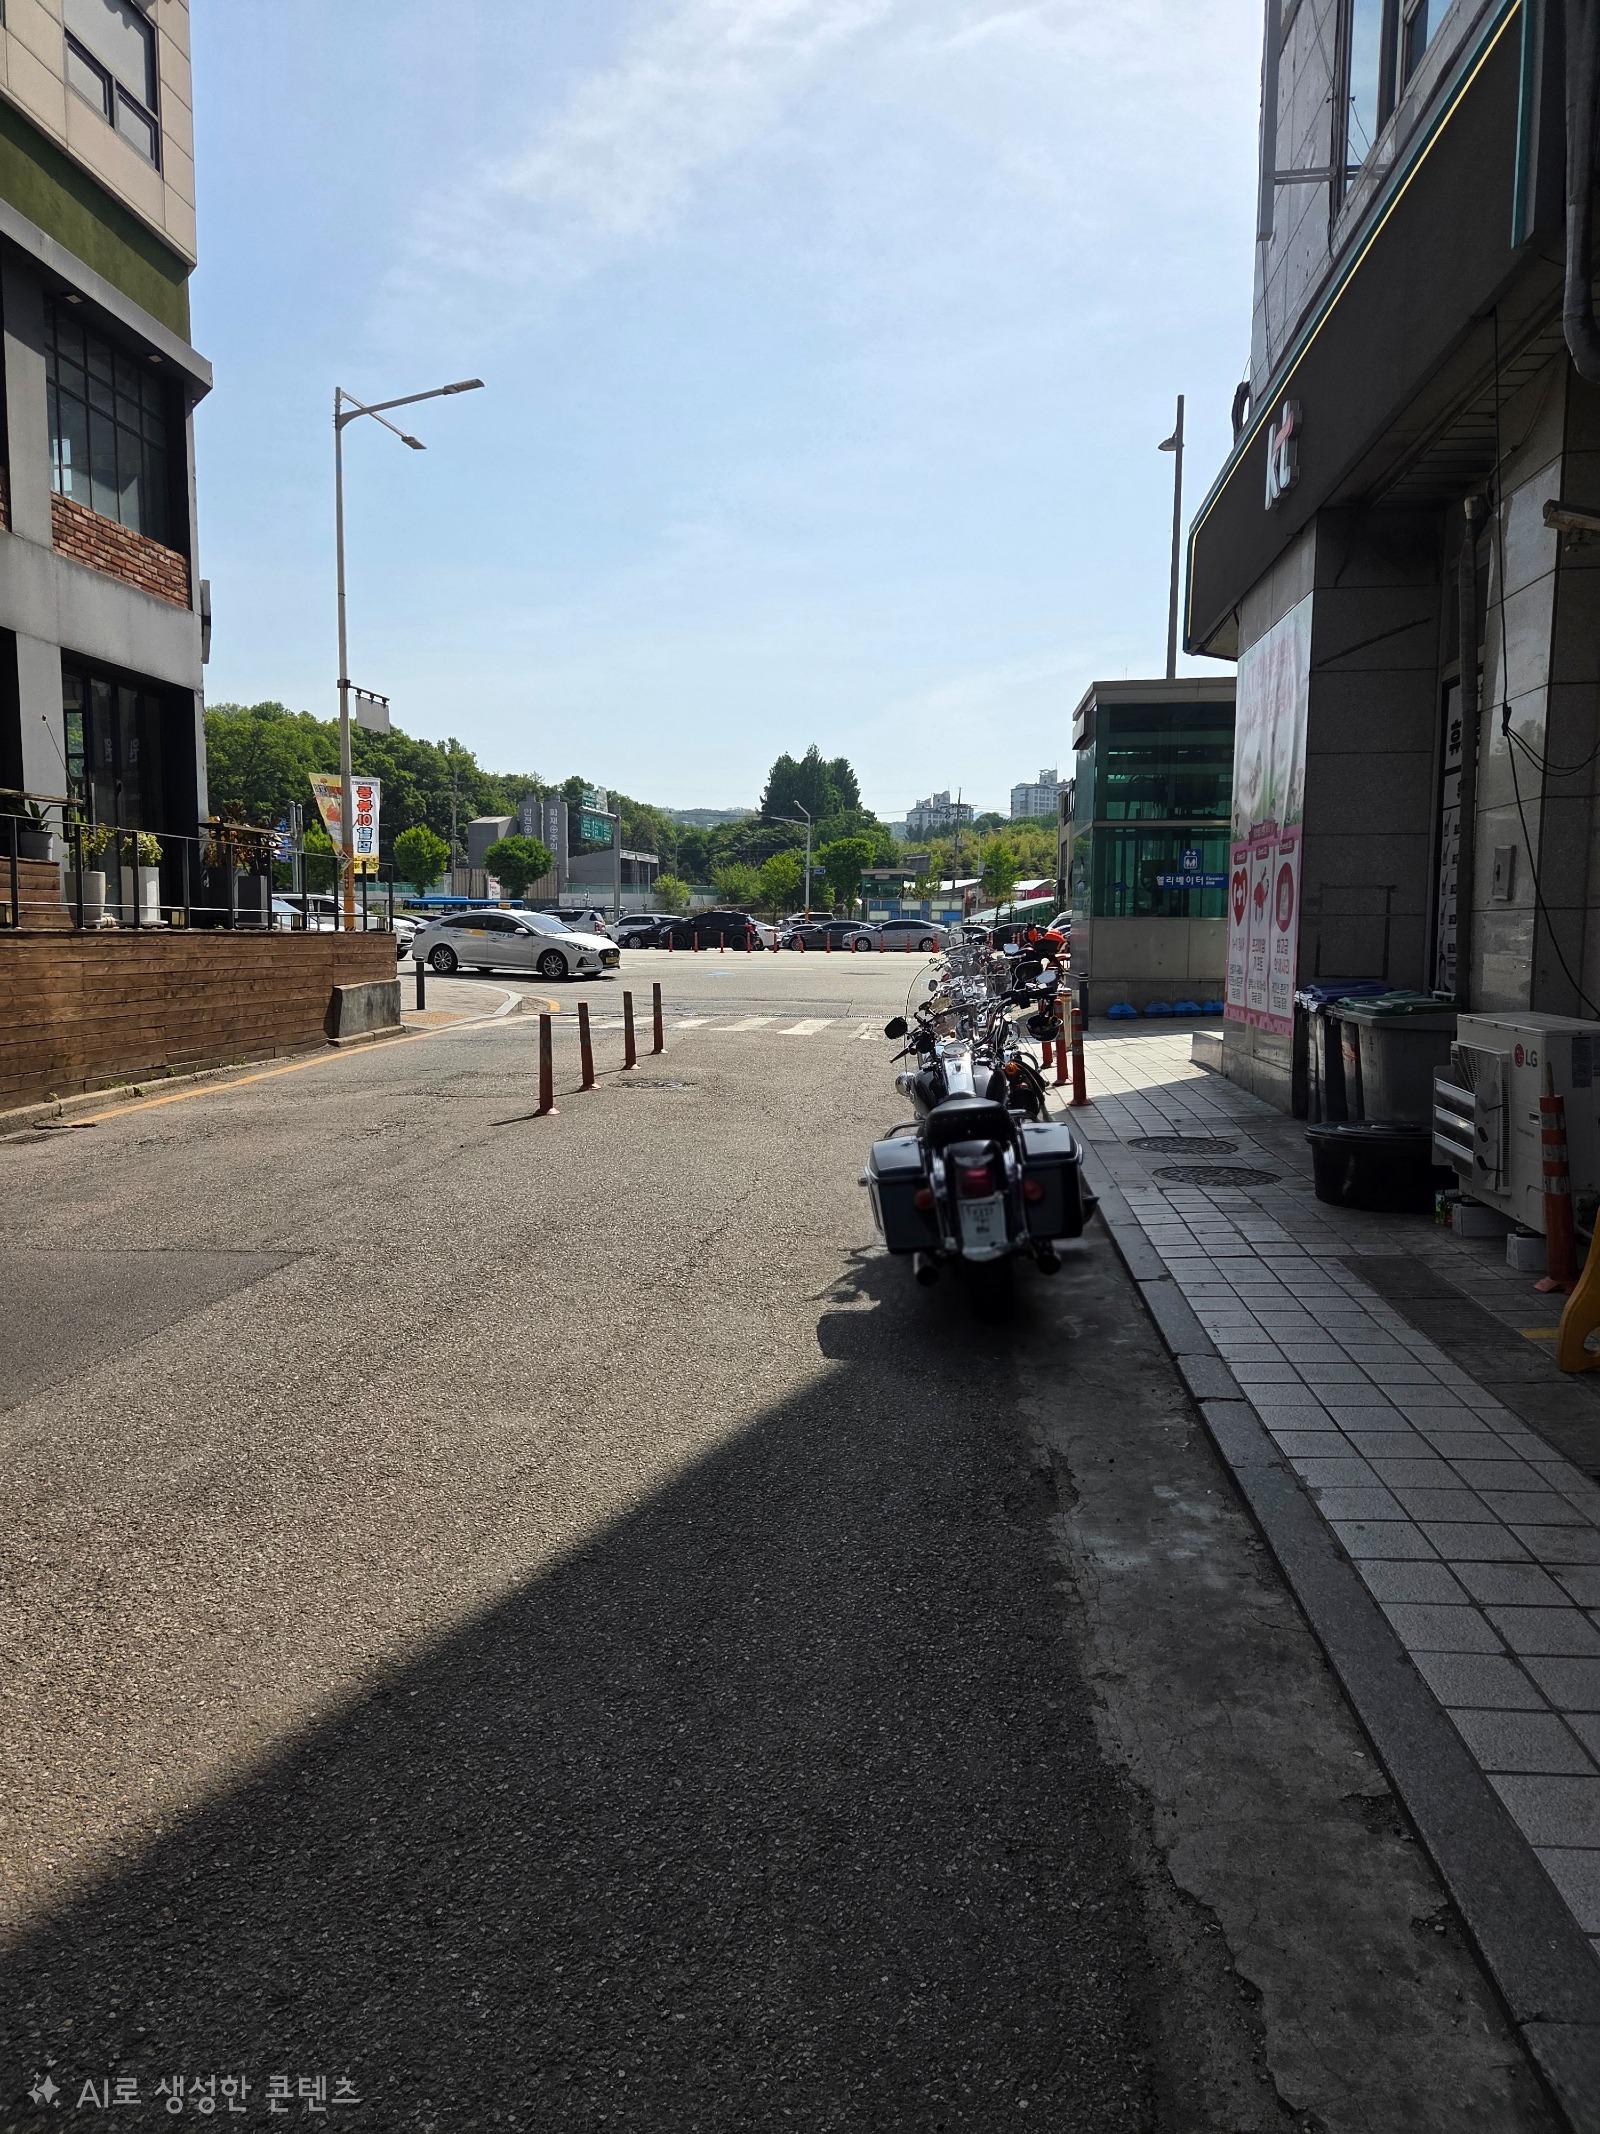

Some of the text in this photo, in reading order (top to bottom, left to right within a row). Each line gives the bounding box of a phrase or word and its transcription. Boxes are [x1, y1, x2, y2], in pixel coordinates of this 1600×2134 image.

[1265, 399, 1298, 511] kt
[549, 834, 559, 851] 주의
[1156, 875, 1204, 886] 엘리베이터
[1525, 1050, 1538, 1068] LG
